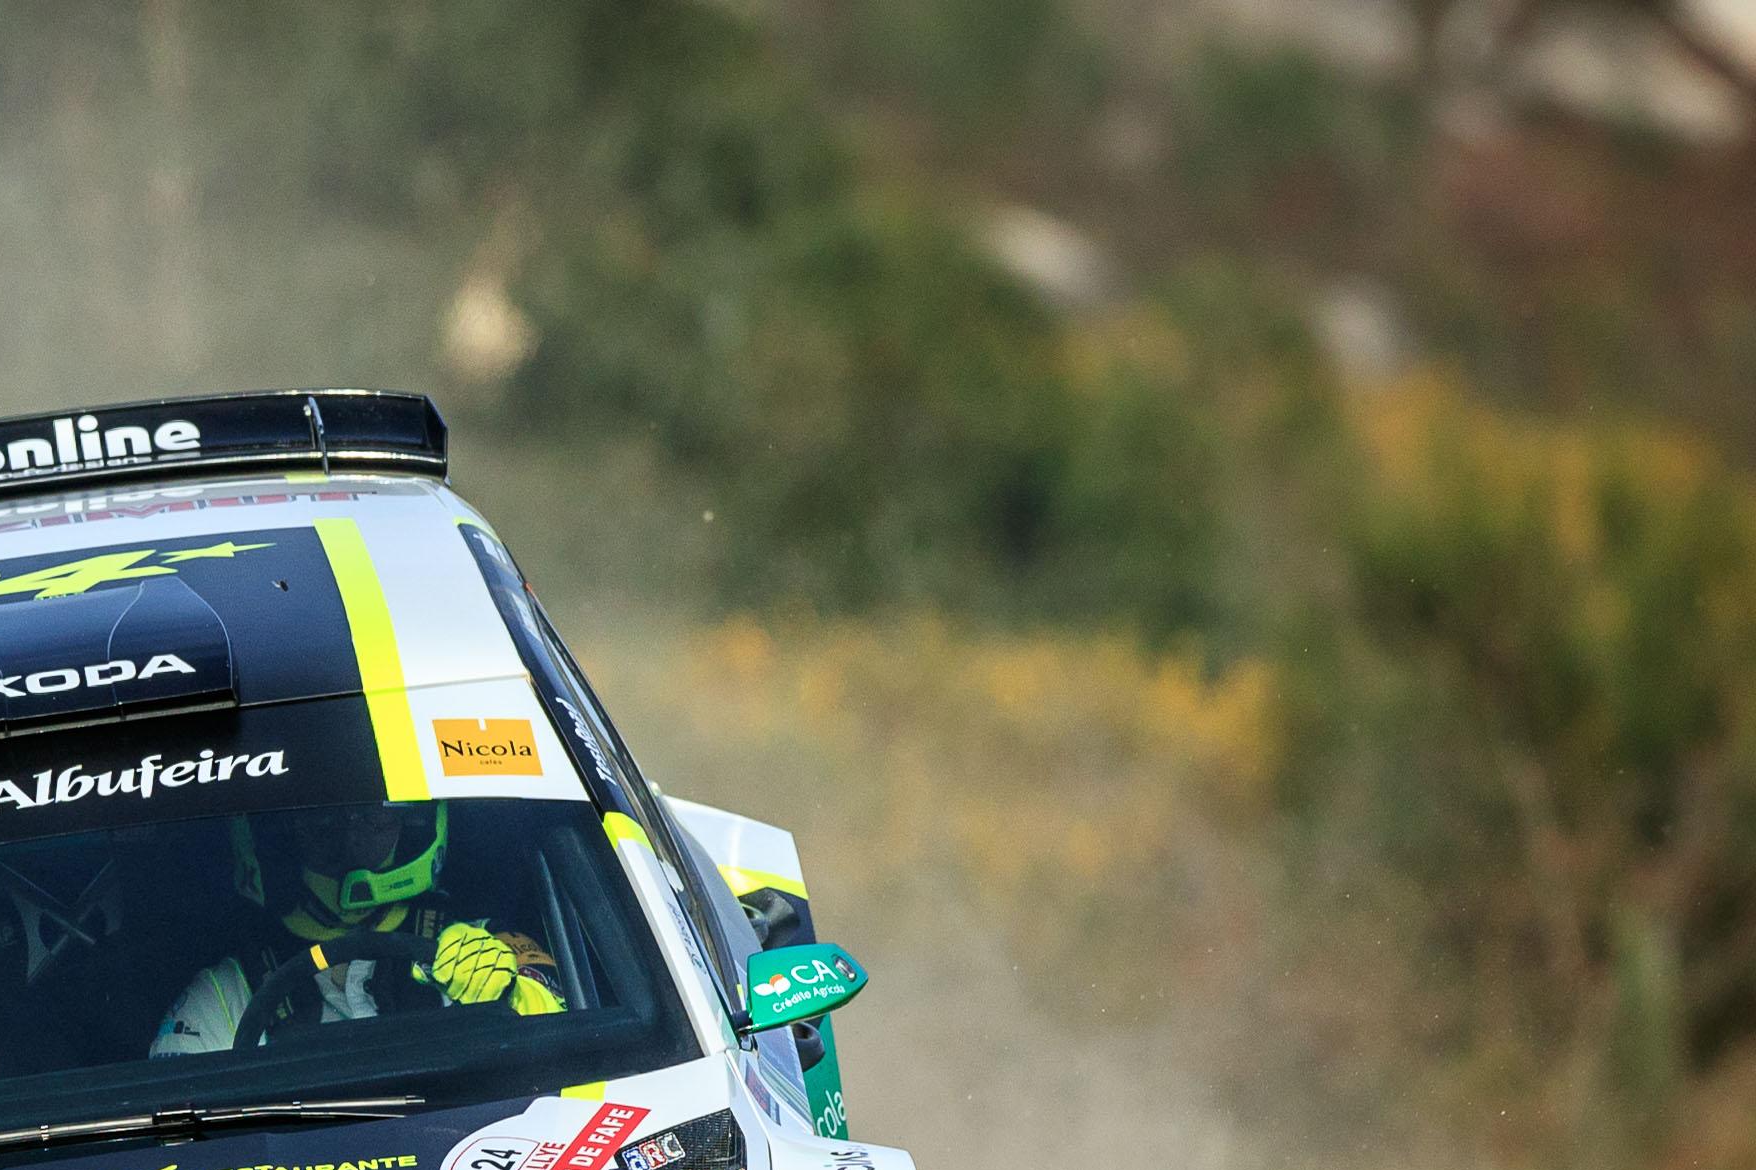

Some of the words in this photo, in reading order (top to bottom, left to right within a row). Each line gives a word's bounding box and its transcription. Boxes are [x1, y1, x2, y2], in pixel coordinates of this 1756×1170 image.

[441, 740, 532, 757] Nicola
[791, 960, 838, 984] CA
[588, 1107, 635, 1146] FAFE
[574, 1145, 604, 1168] DE
